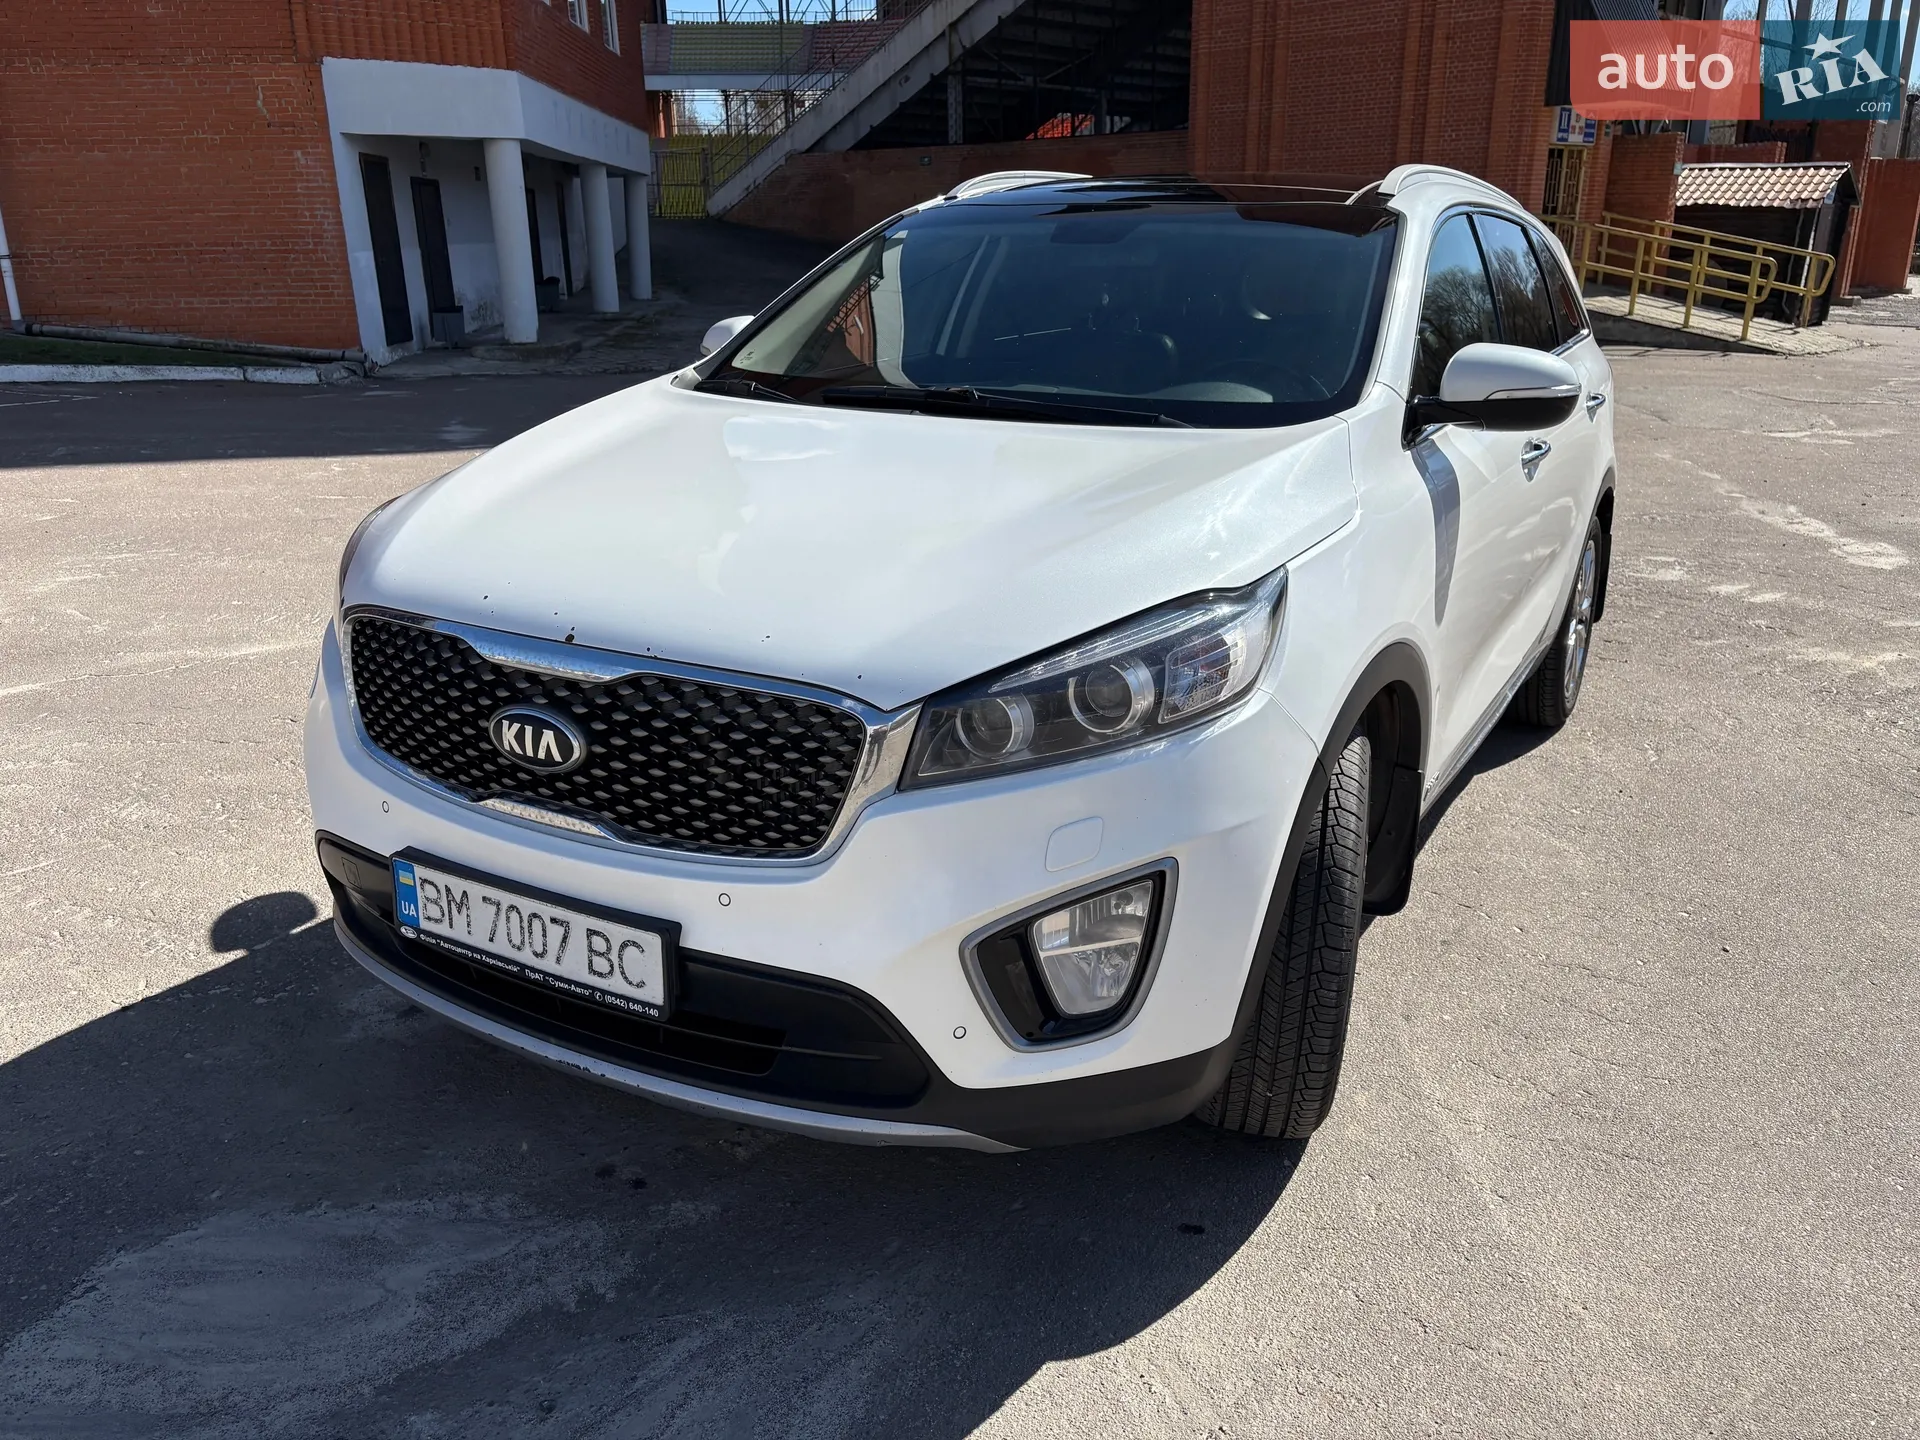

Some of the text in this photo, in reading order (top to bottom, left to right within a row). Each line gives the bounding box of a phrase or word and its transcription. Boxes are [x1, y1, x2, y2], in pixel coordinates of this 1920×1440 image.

[502, 719, 563, 762] KIA
[401, 900, 418, 918] UA
[482, 895, 571, 966] 7007
[473, 952, 481, 960] на
[525, 968, 544, 982] ПрАТ
[545, 976, 593, 996] "Суми-Авто"
[604, 994, 628, 1010] (0542)
[629, 1003, 659, 1018] 640-140
